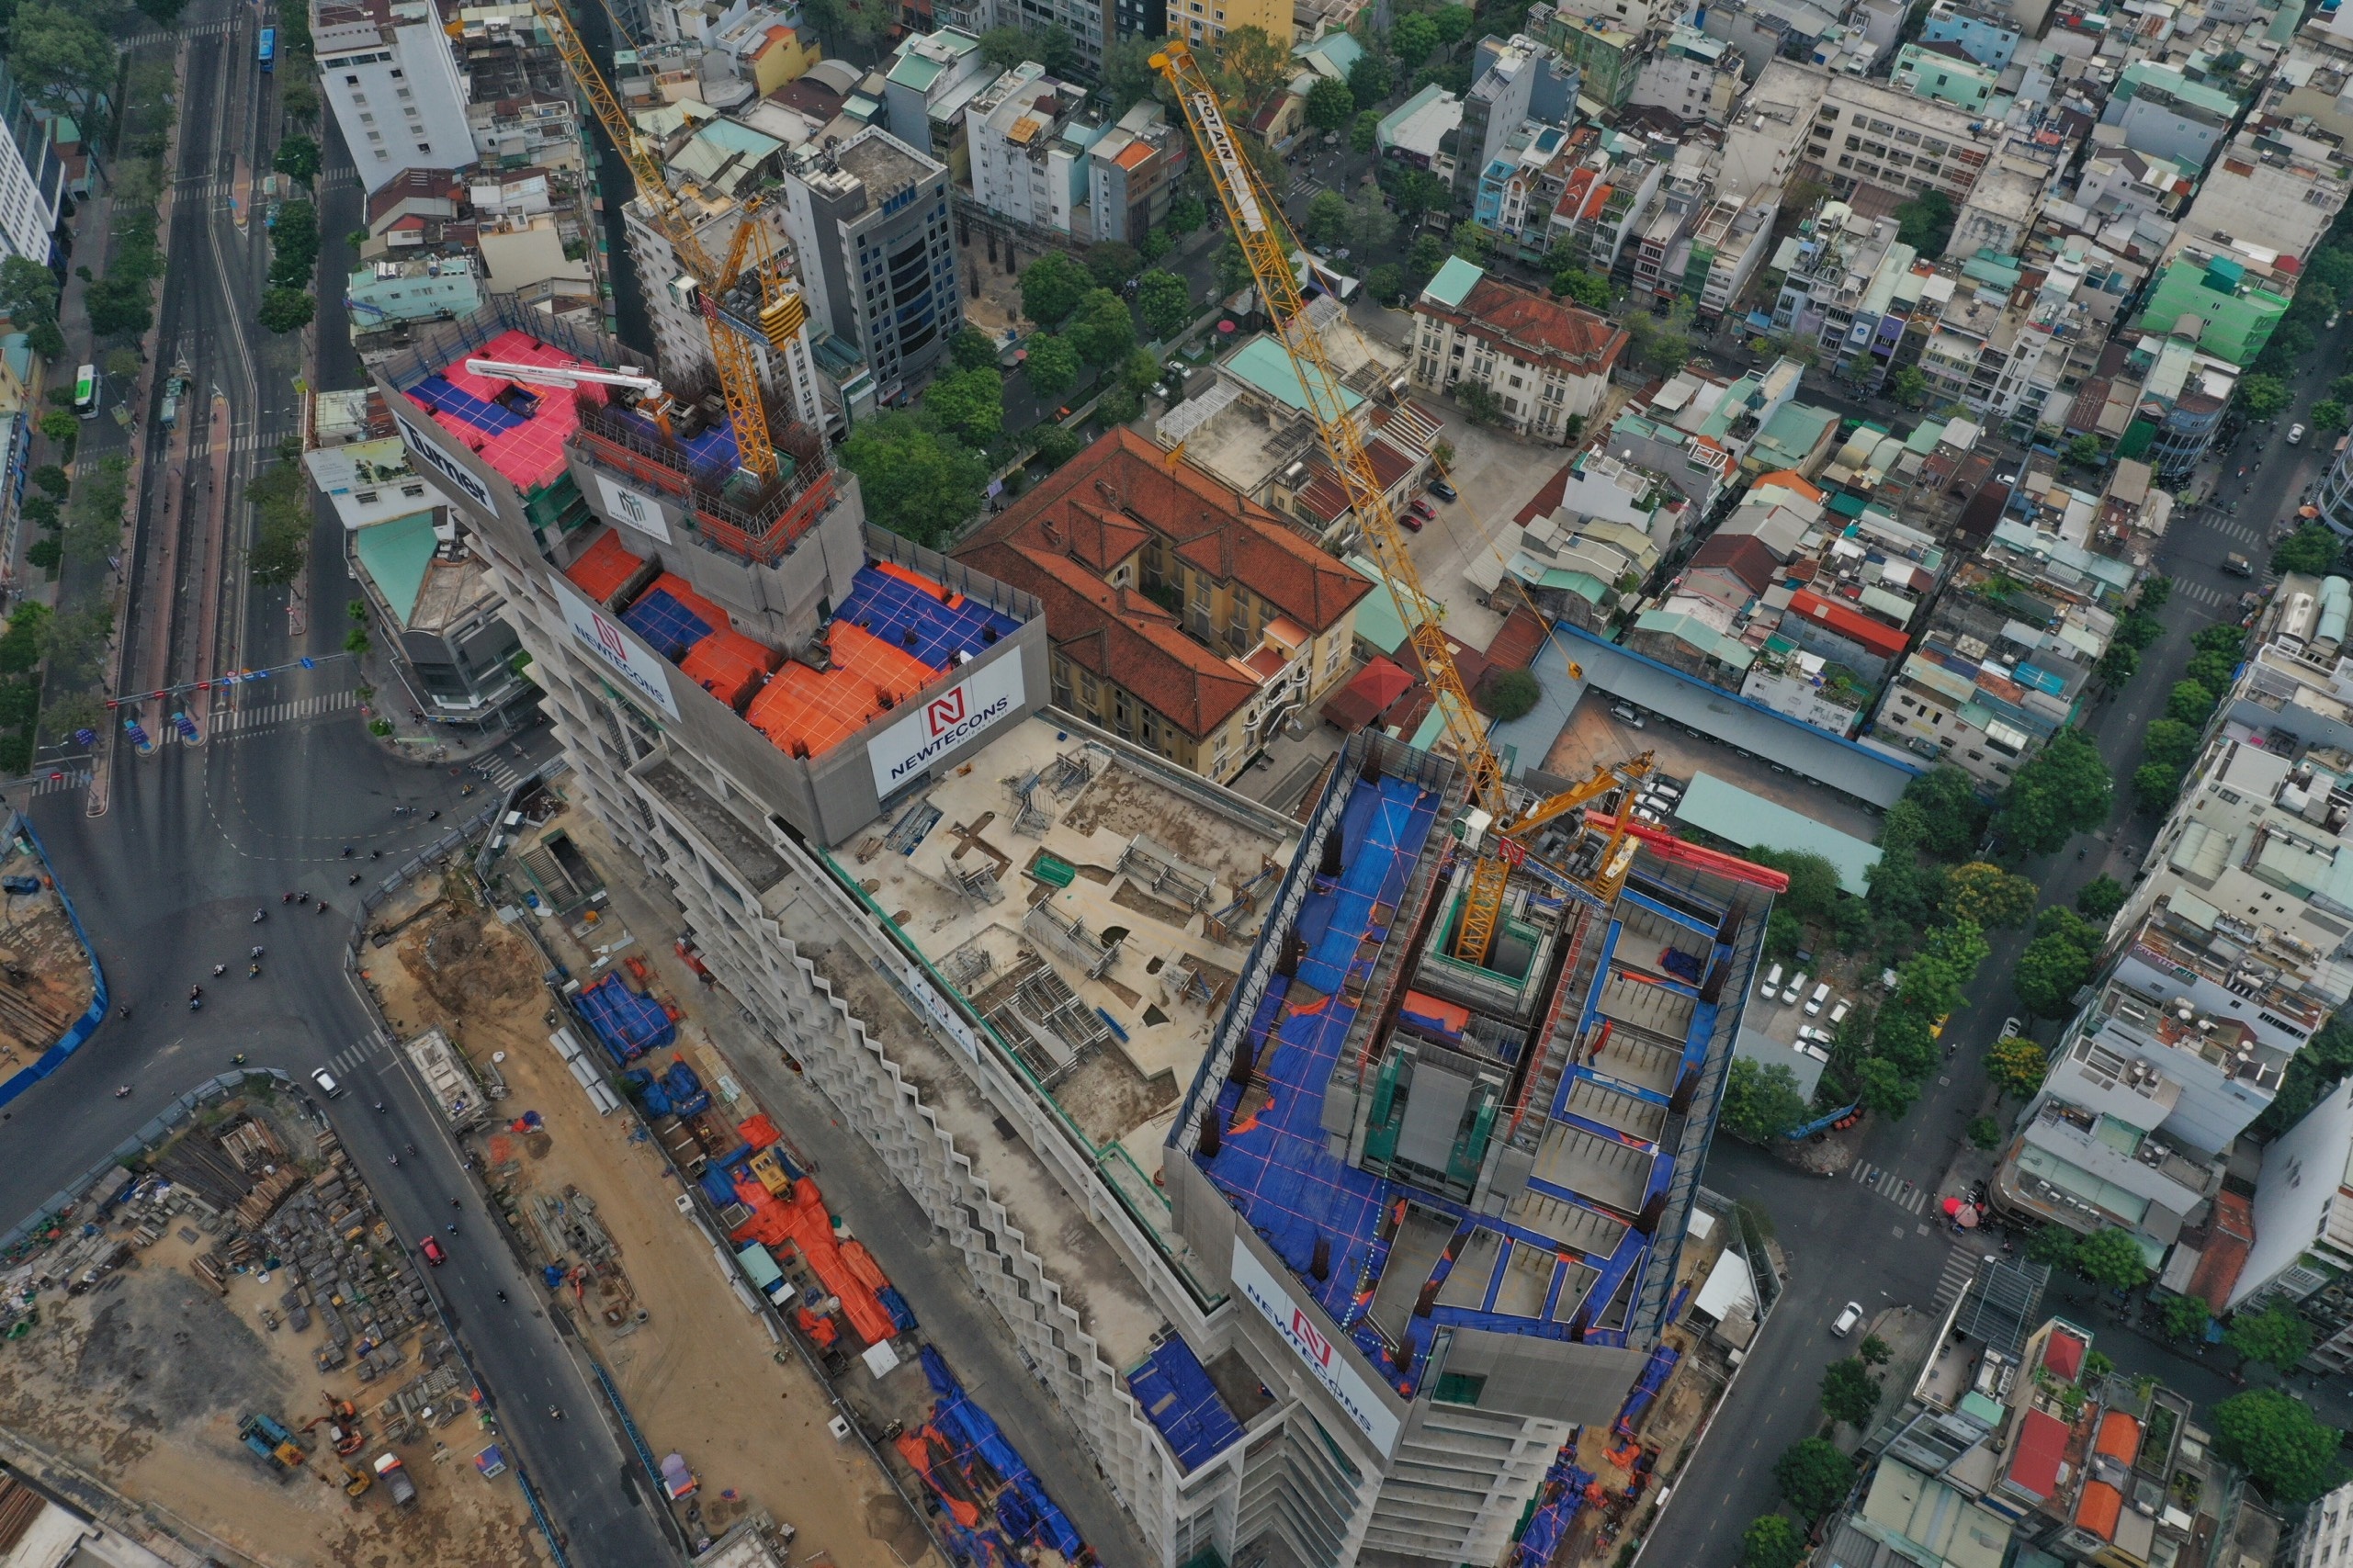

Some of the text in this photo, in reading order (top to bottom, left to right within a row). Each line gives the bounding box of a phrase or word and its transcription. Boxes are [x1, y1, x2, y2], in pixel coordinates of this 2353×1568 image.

[1198, 94, 1234, 160] POTAIN
[1990, 407, 2008, 416] 127
[398, 416, 488, 506] Turner
[574, 623, 665, 704] NEWTECONS
[891, 697, 1008, 780] NEWTECONS
[2175, 966, 2199, 981] HOTEL
[1248, 1283, 1372, 1433] NEWTECONS
